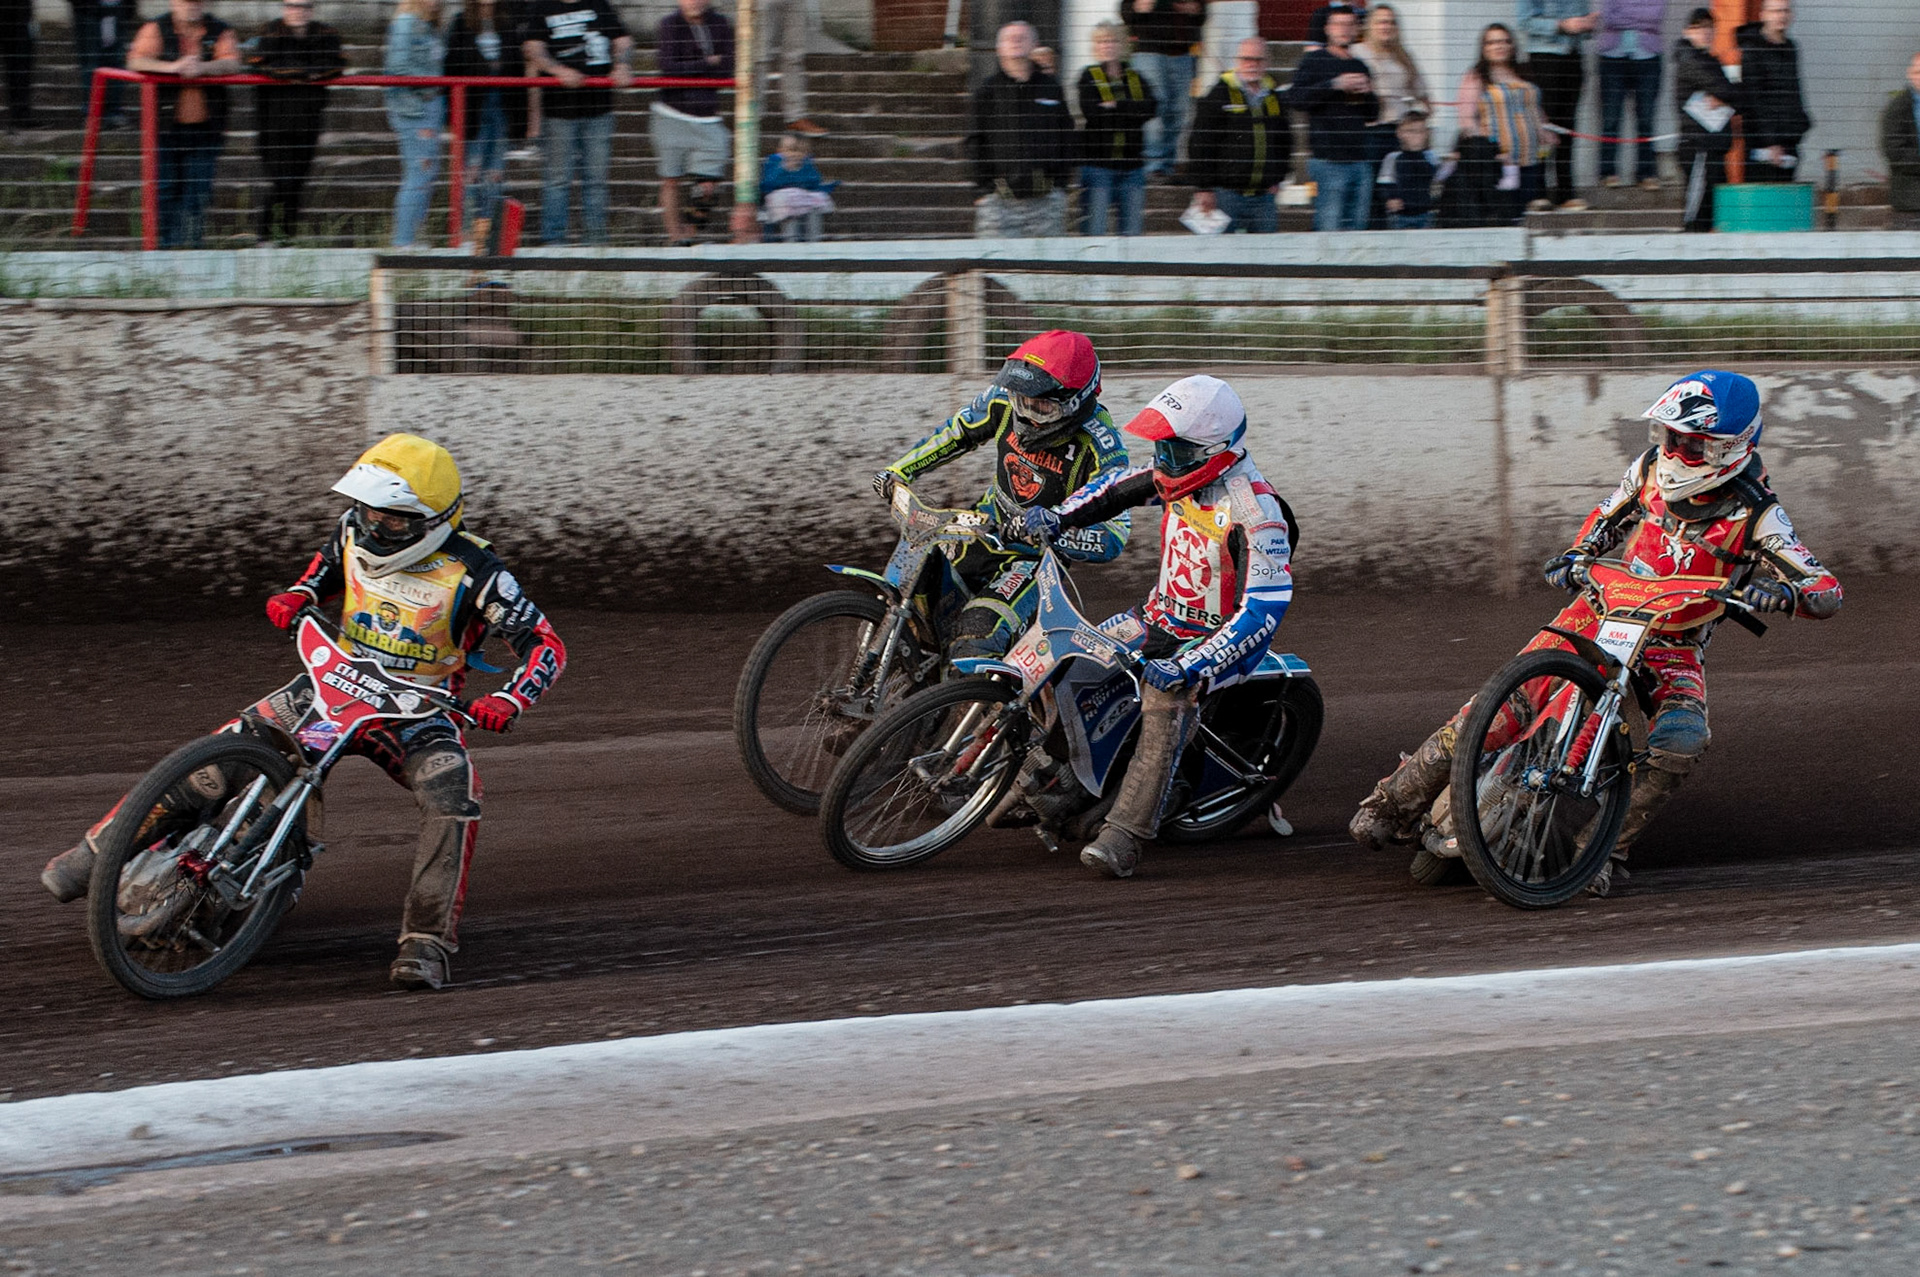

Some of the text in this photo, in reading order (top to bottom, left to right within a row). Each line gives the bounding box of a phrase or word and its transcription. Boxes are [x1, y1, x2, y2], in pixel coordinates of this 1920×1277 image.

[1065, 444, 1076, 461] 1
[1054, 537, 1105, 554] ONDA
[1158, 592, 1221, 626] POTTERS
[341, 617, 438, 664] WARRIORS
[1073, 631, 1097, 651] CYCLES
[1183, 625, 1239, 665] Spot
[1198, 613, 1278, 680] Roofing
[1597, 637, 1636, 649] FORKLIFTS
[1608, 631, 1629, 641] KMA
[333, 662, 392, 695] CTA FIRE
